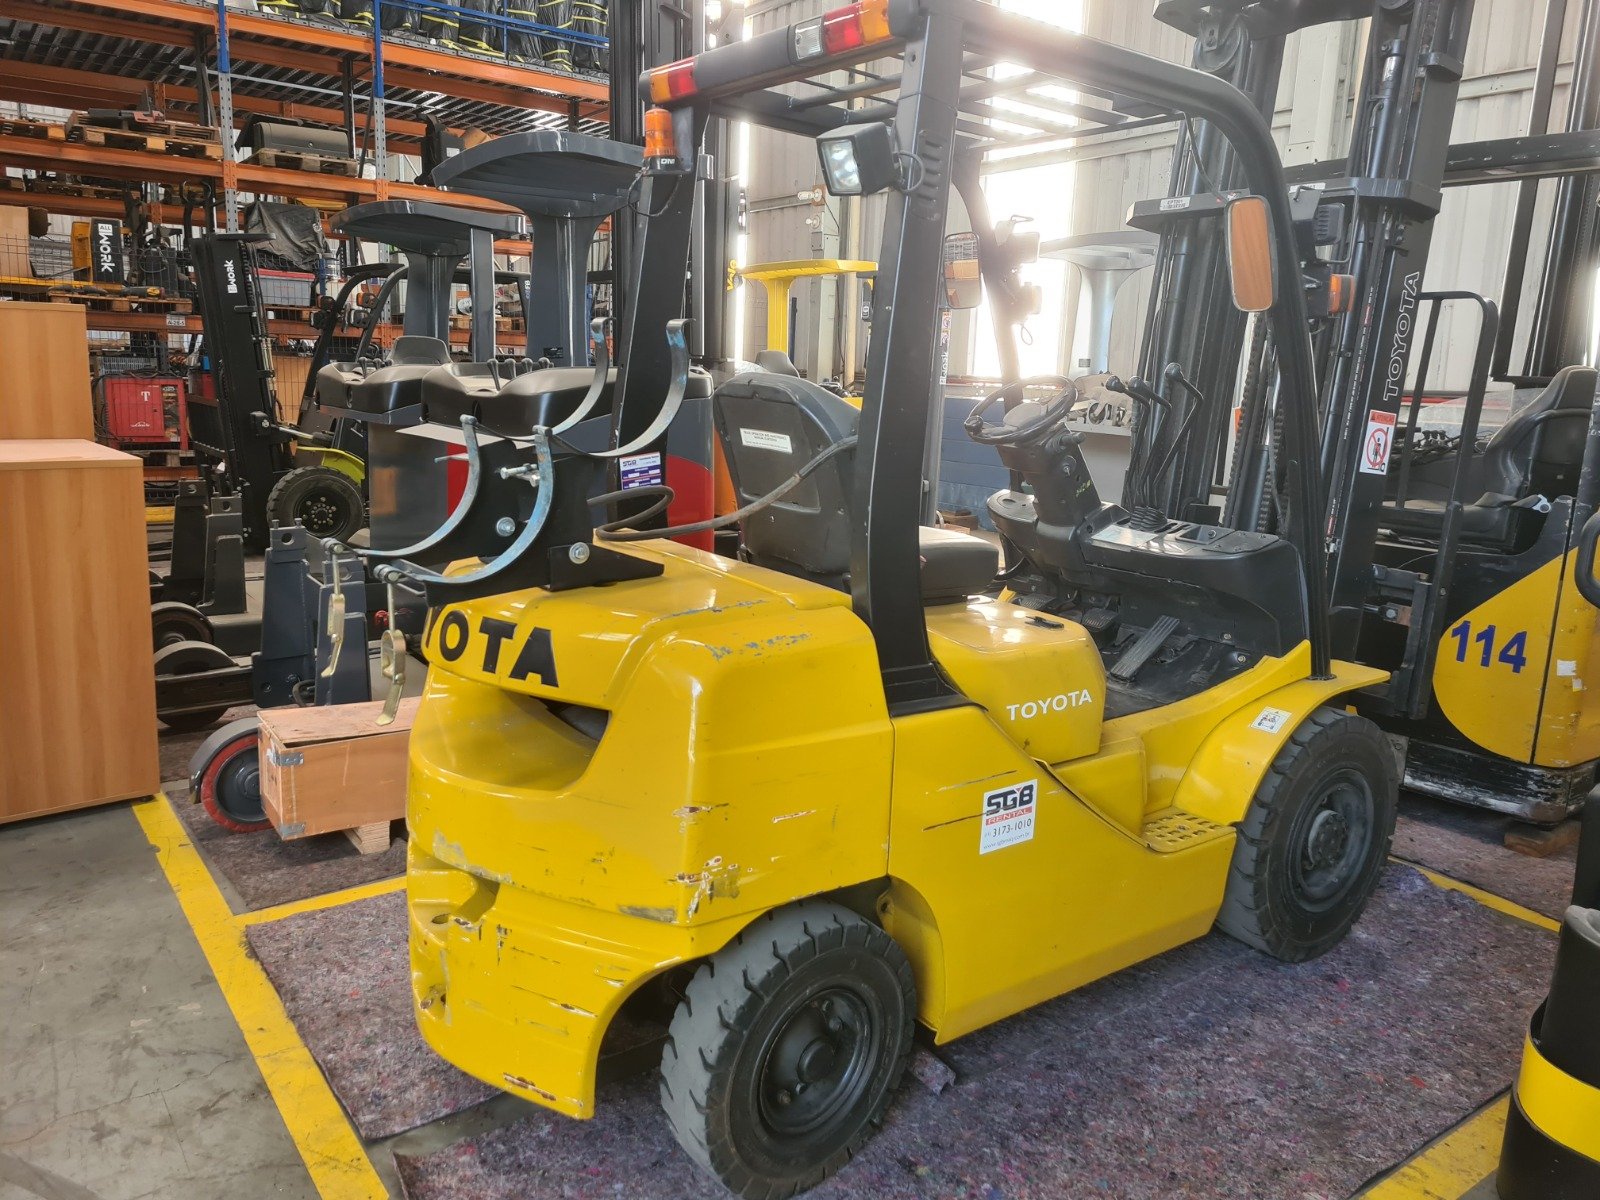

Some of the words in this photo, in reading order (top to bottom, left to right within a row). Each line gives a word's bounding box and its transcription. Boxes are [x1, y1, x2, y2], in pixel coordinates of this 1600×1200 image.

[1383, 271, 1420, 401] TOYOTA
[1451, 620, 1527, 674] 114
[1006, 688, 1093, 721] TOYOTA
[986, 784, 1034, 816] SGB
[988, 808, 1030, 825] RENTAL
[993, 818, 1032, 838] 3173-1010
